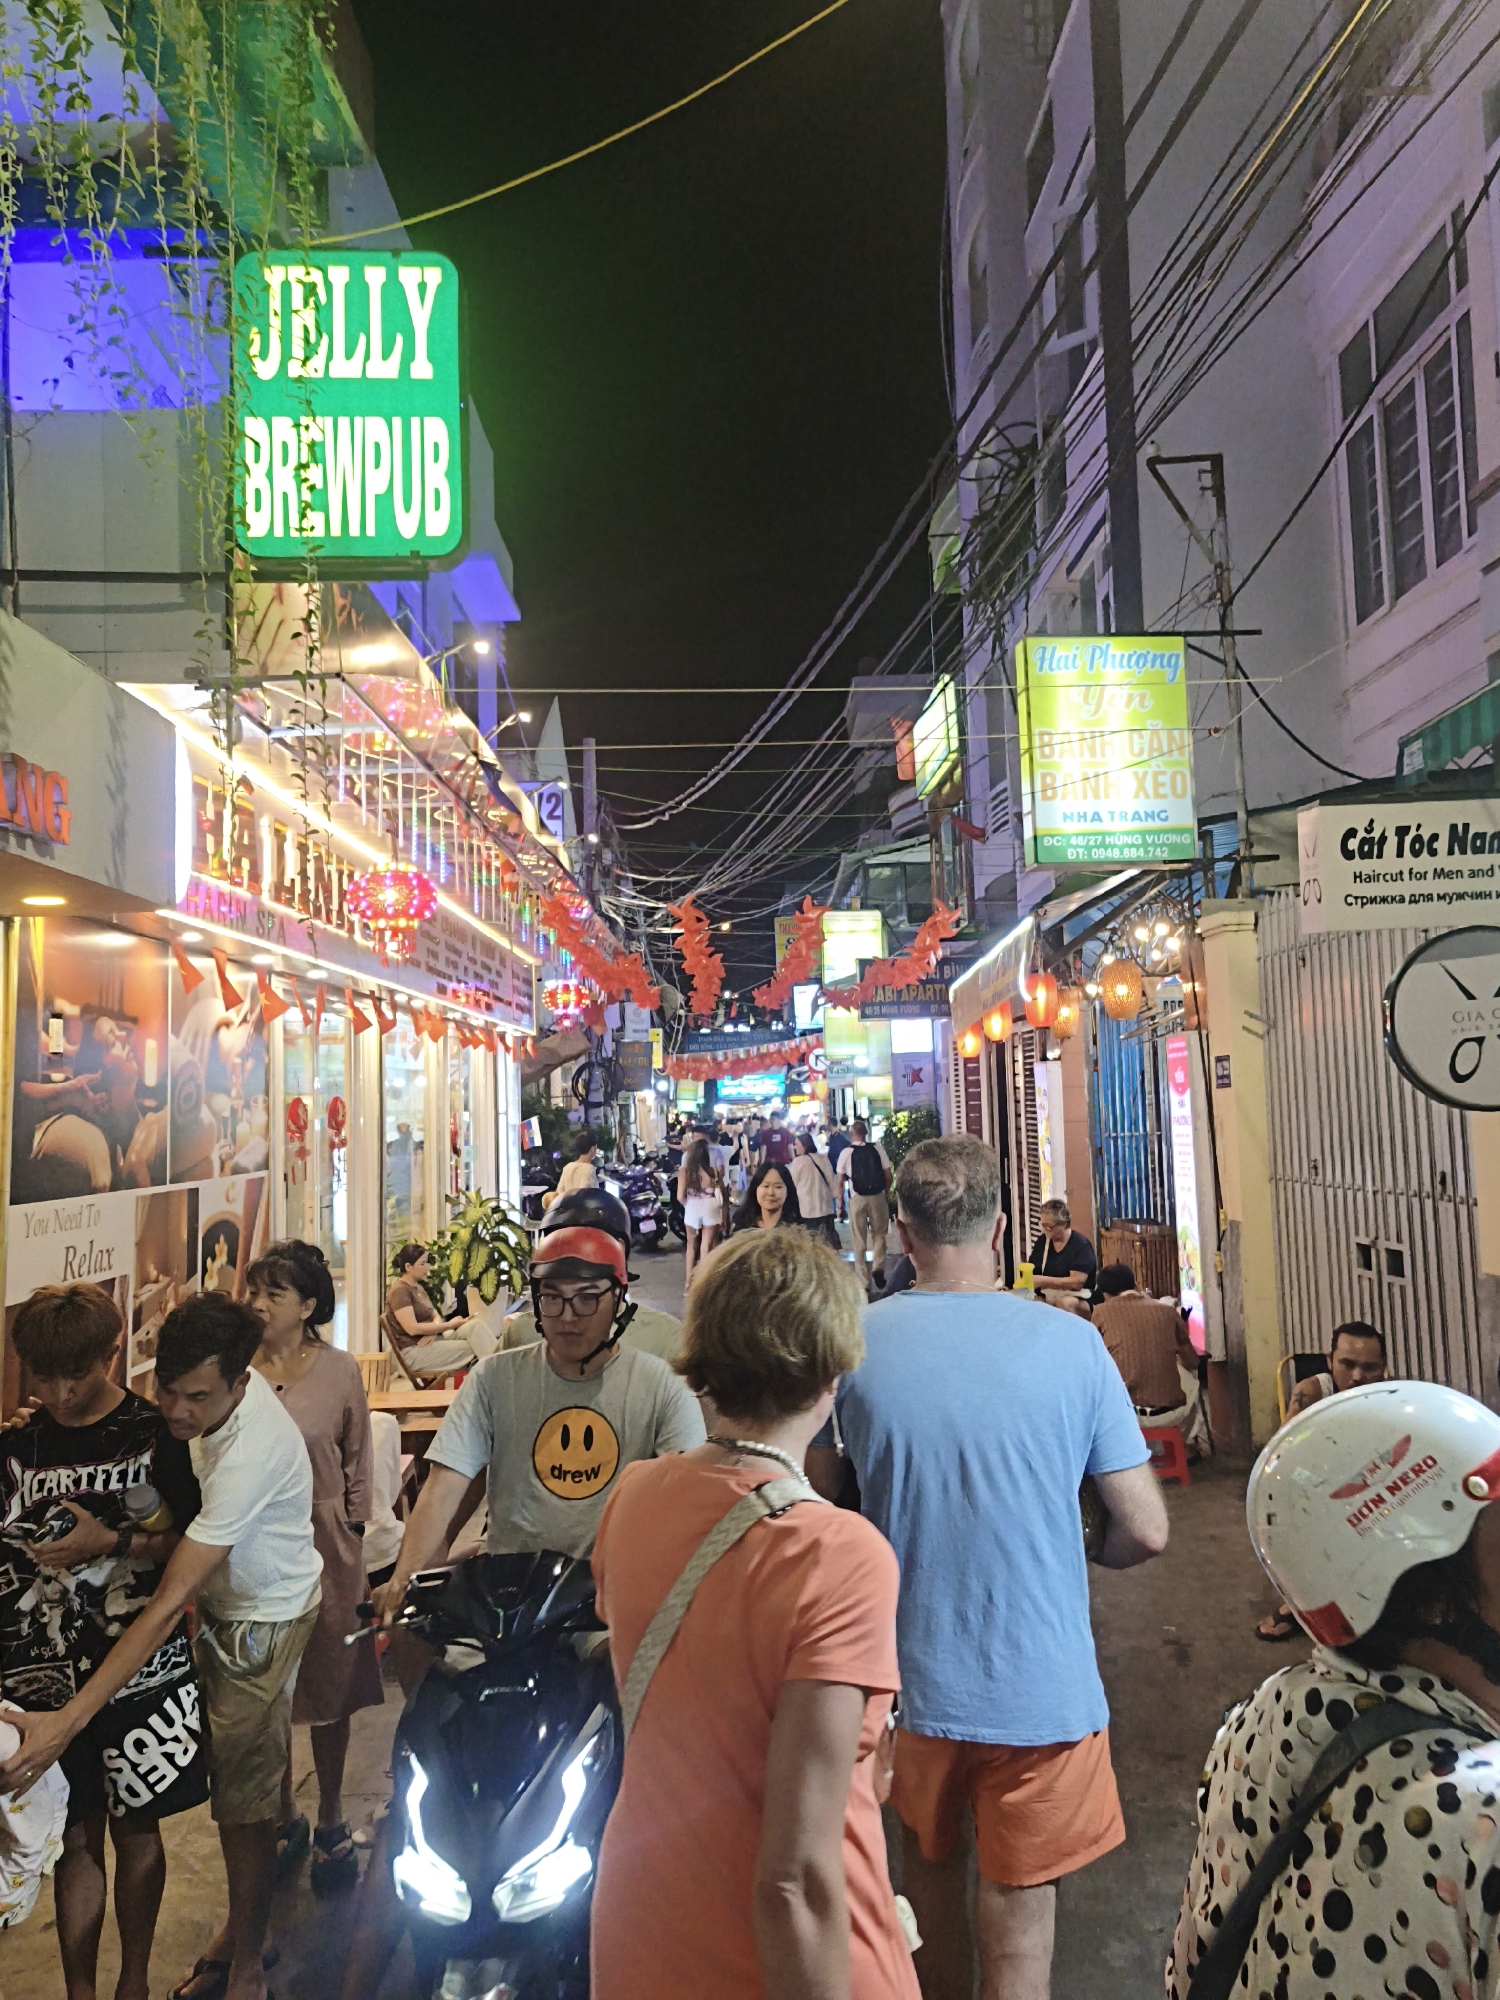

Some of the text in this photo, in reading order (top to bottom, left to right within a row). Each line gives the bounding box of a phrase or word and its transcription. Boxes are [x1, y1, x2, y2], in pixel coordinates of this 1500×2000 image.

[249, 265, 443, 381] JELLY
[244, 416, 451, 539] BREWPUB
[1034, 643, 1182, 684] Hai Phượng
[1127, 721, 1186, 758] CĂN
[1131, 763, 1188, 800] XÈO
[1062, 810, 1169, 824] NHA TRANG
[1070, 835, 1101, 846] 46/27
[1105, 832, 1142, 845] HÙNG
[1146, 832, 1191, 845] VƯƠNG
[1091, 847, 1169, 859] 0948.684.742
[1340, 818, 1388, 861] Cắt
[1395, 823, 1440, 859] Tóc
[1353, 868, 1405, 884] Haircut
[1408, 866, 1428, 882] for
[1433, 867, 1464, 880] Men
[1467, 863, 1495, 879] and
[1344, 893, 1405, 909] Стрижка
[1408, 894, 1433, 905] для
[1436, 889, 1493, 905] мужчин
[255, 906, 287, 946] SPA
[1452, 1010, 1485, 1024] GIA
[24, 1203, 101, 1239] You Need To
[62, 1239, 115, 1283] Relax
[3, 1447, 153, 1530] HEARTFELT
[550, 1463, 602, 1484] drew
[1384, 1454, 1438, 1498] NERO
